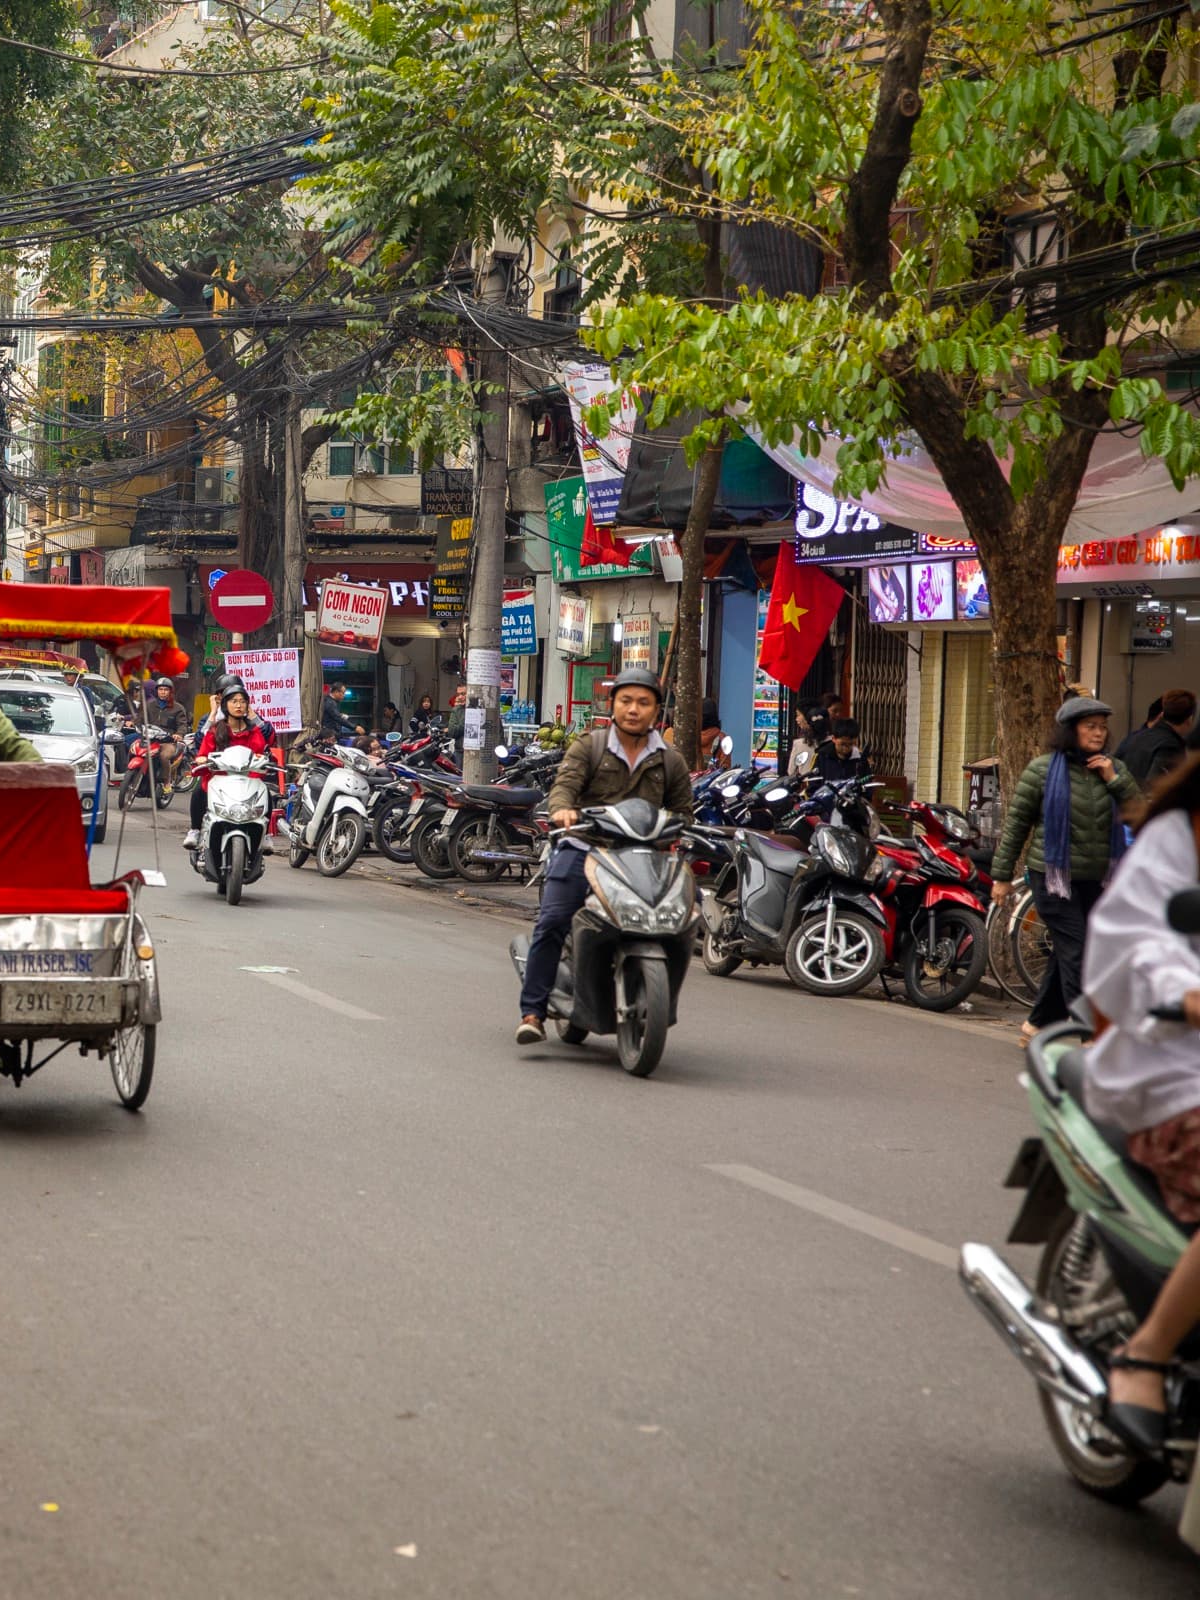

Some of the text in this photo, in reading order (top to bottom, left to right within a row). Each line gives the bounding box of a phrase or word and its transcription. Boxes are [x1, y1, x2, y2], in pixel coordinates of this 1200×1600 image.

[325, 590, 382, 617] CƠM NGON
[518, 615, 532, 625] TA
[245, 666, 255, 677] CÁ
[245, 680, 269, 690] THANG
[267, 706, 286, 717] NGAN
